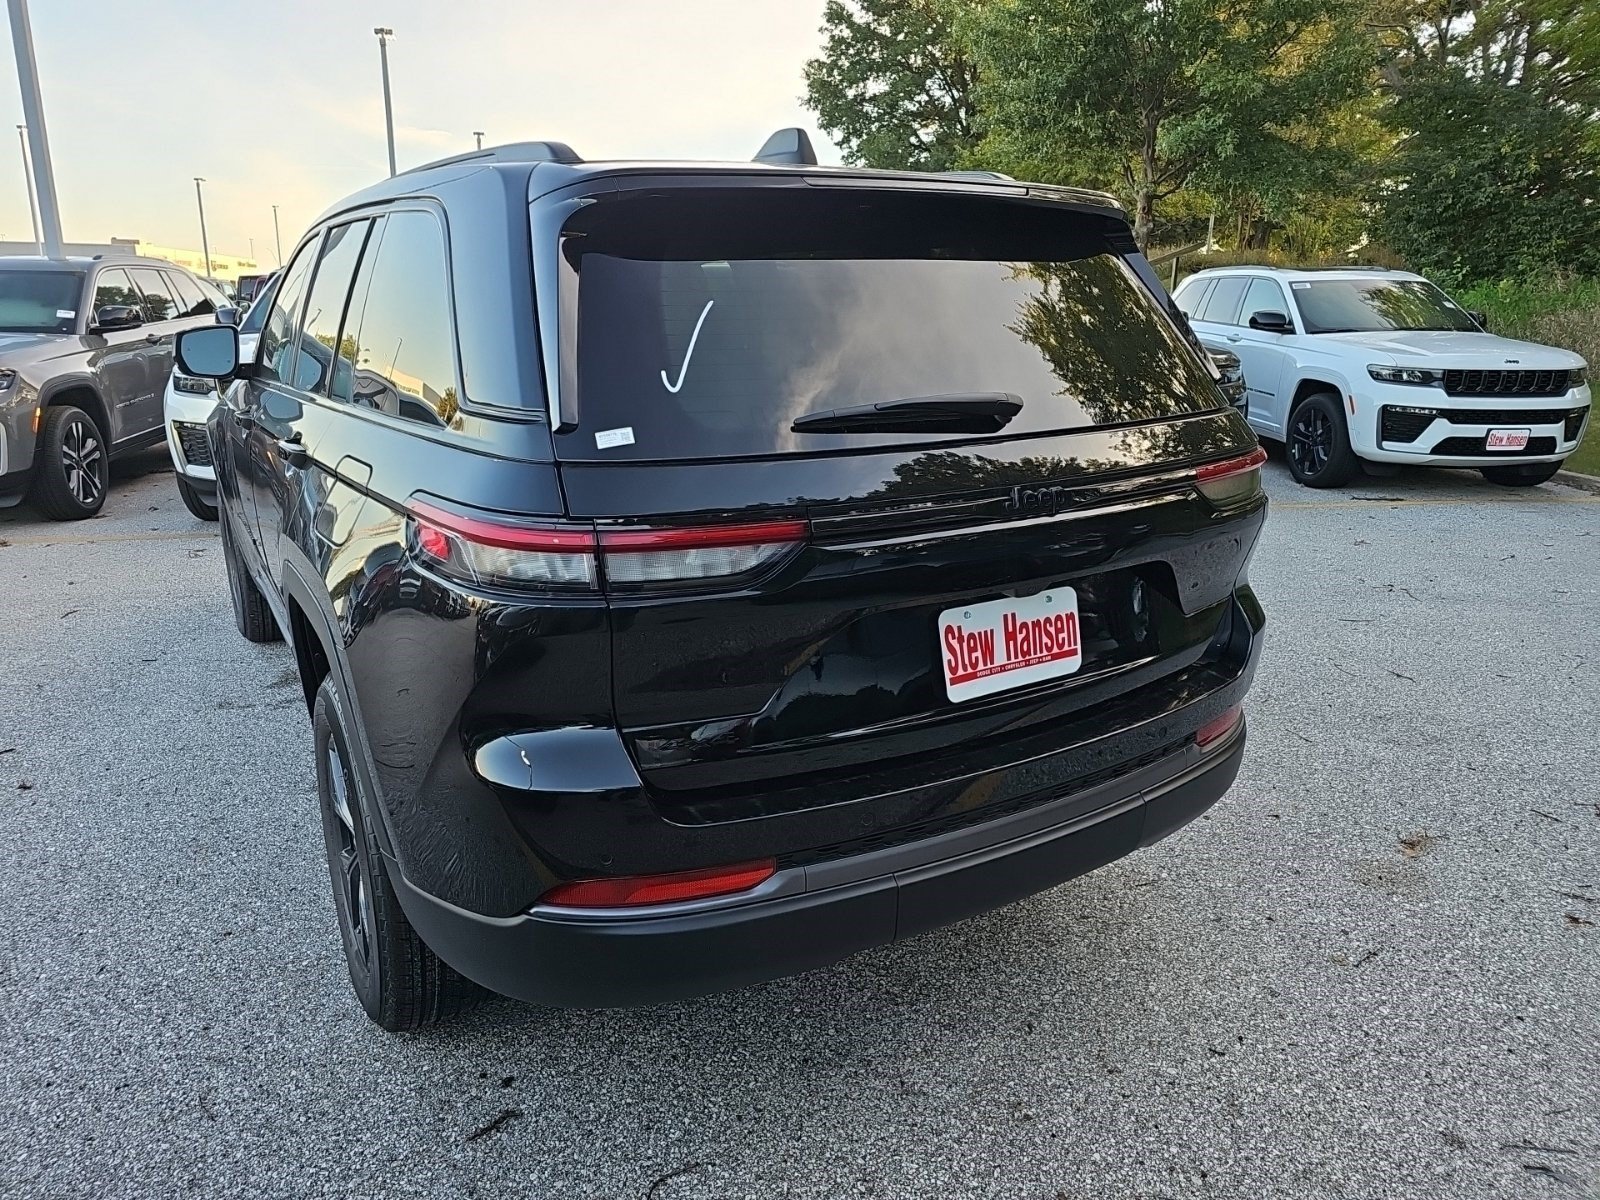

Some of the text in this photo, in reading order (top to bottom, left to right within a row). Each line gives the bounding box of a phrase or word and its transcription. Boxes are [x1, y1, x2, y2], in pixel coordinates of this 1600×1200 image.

[1488, 433, 1528, 446] Stew Hansen
[1003, 485, 1064, 515] Jeep
[944, 611, 1078, 676] Stew Hansen
